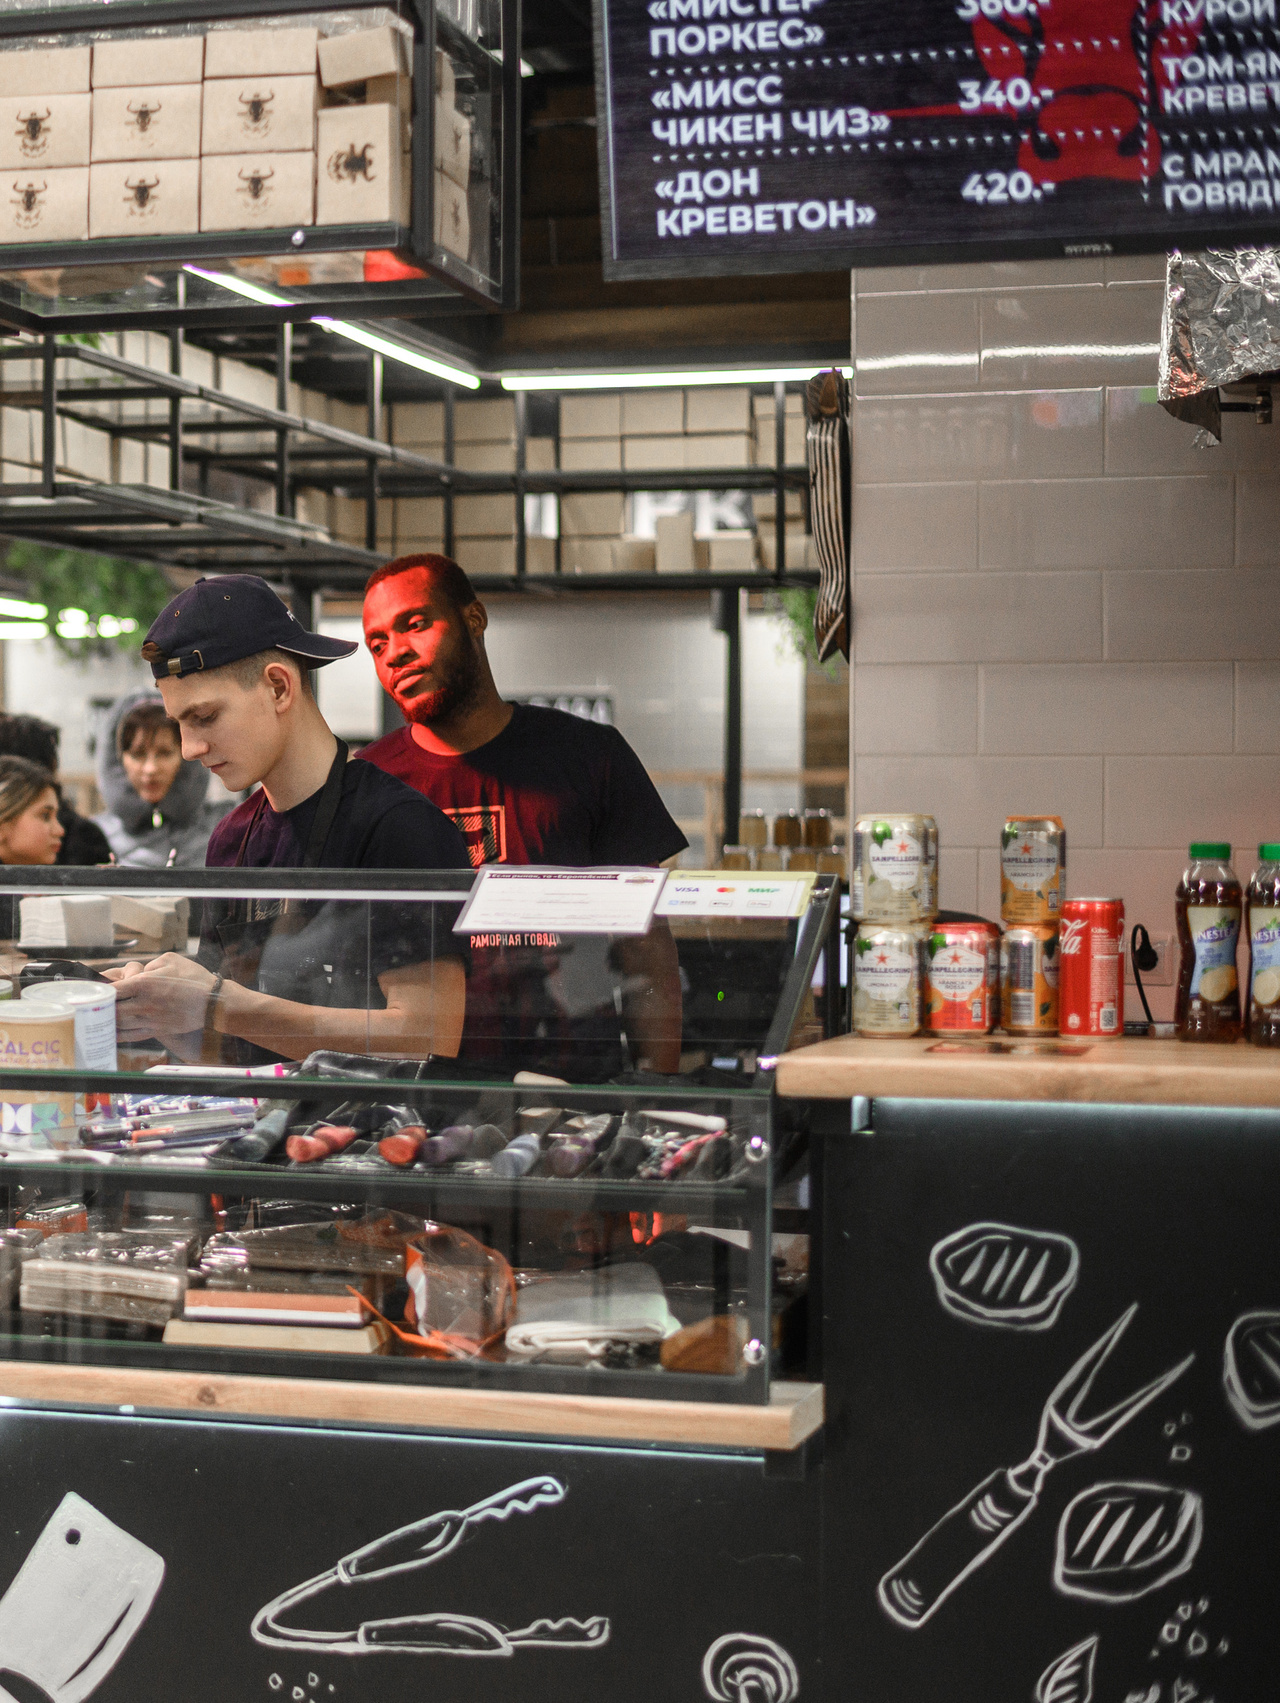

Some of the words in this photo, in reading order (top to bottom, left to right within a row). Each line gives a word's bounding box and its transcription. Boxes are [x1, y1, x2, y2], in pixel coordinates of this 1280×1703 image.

[650, 19, 824, 57] ПОРКЕС»
[651, 75, 783, 110] «МИСС
[957, 78, 1054, 111] 340.-
[652, 113, 782, 147] ЧИКЕН
[791, 106, 891, 140] ЧИЗ»
[1163, 154, 1185, 179] С
[655, 167, 760, 204] «ДОН
[961, 171, 1056, 204] 420.-
[1164, 180, 1280, 211] ГОВЯД
[657, 199, 877, 237] КРЕВЕТОН»
[470, 933, 521, 949] РАМОРНАЯ
